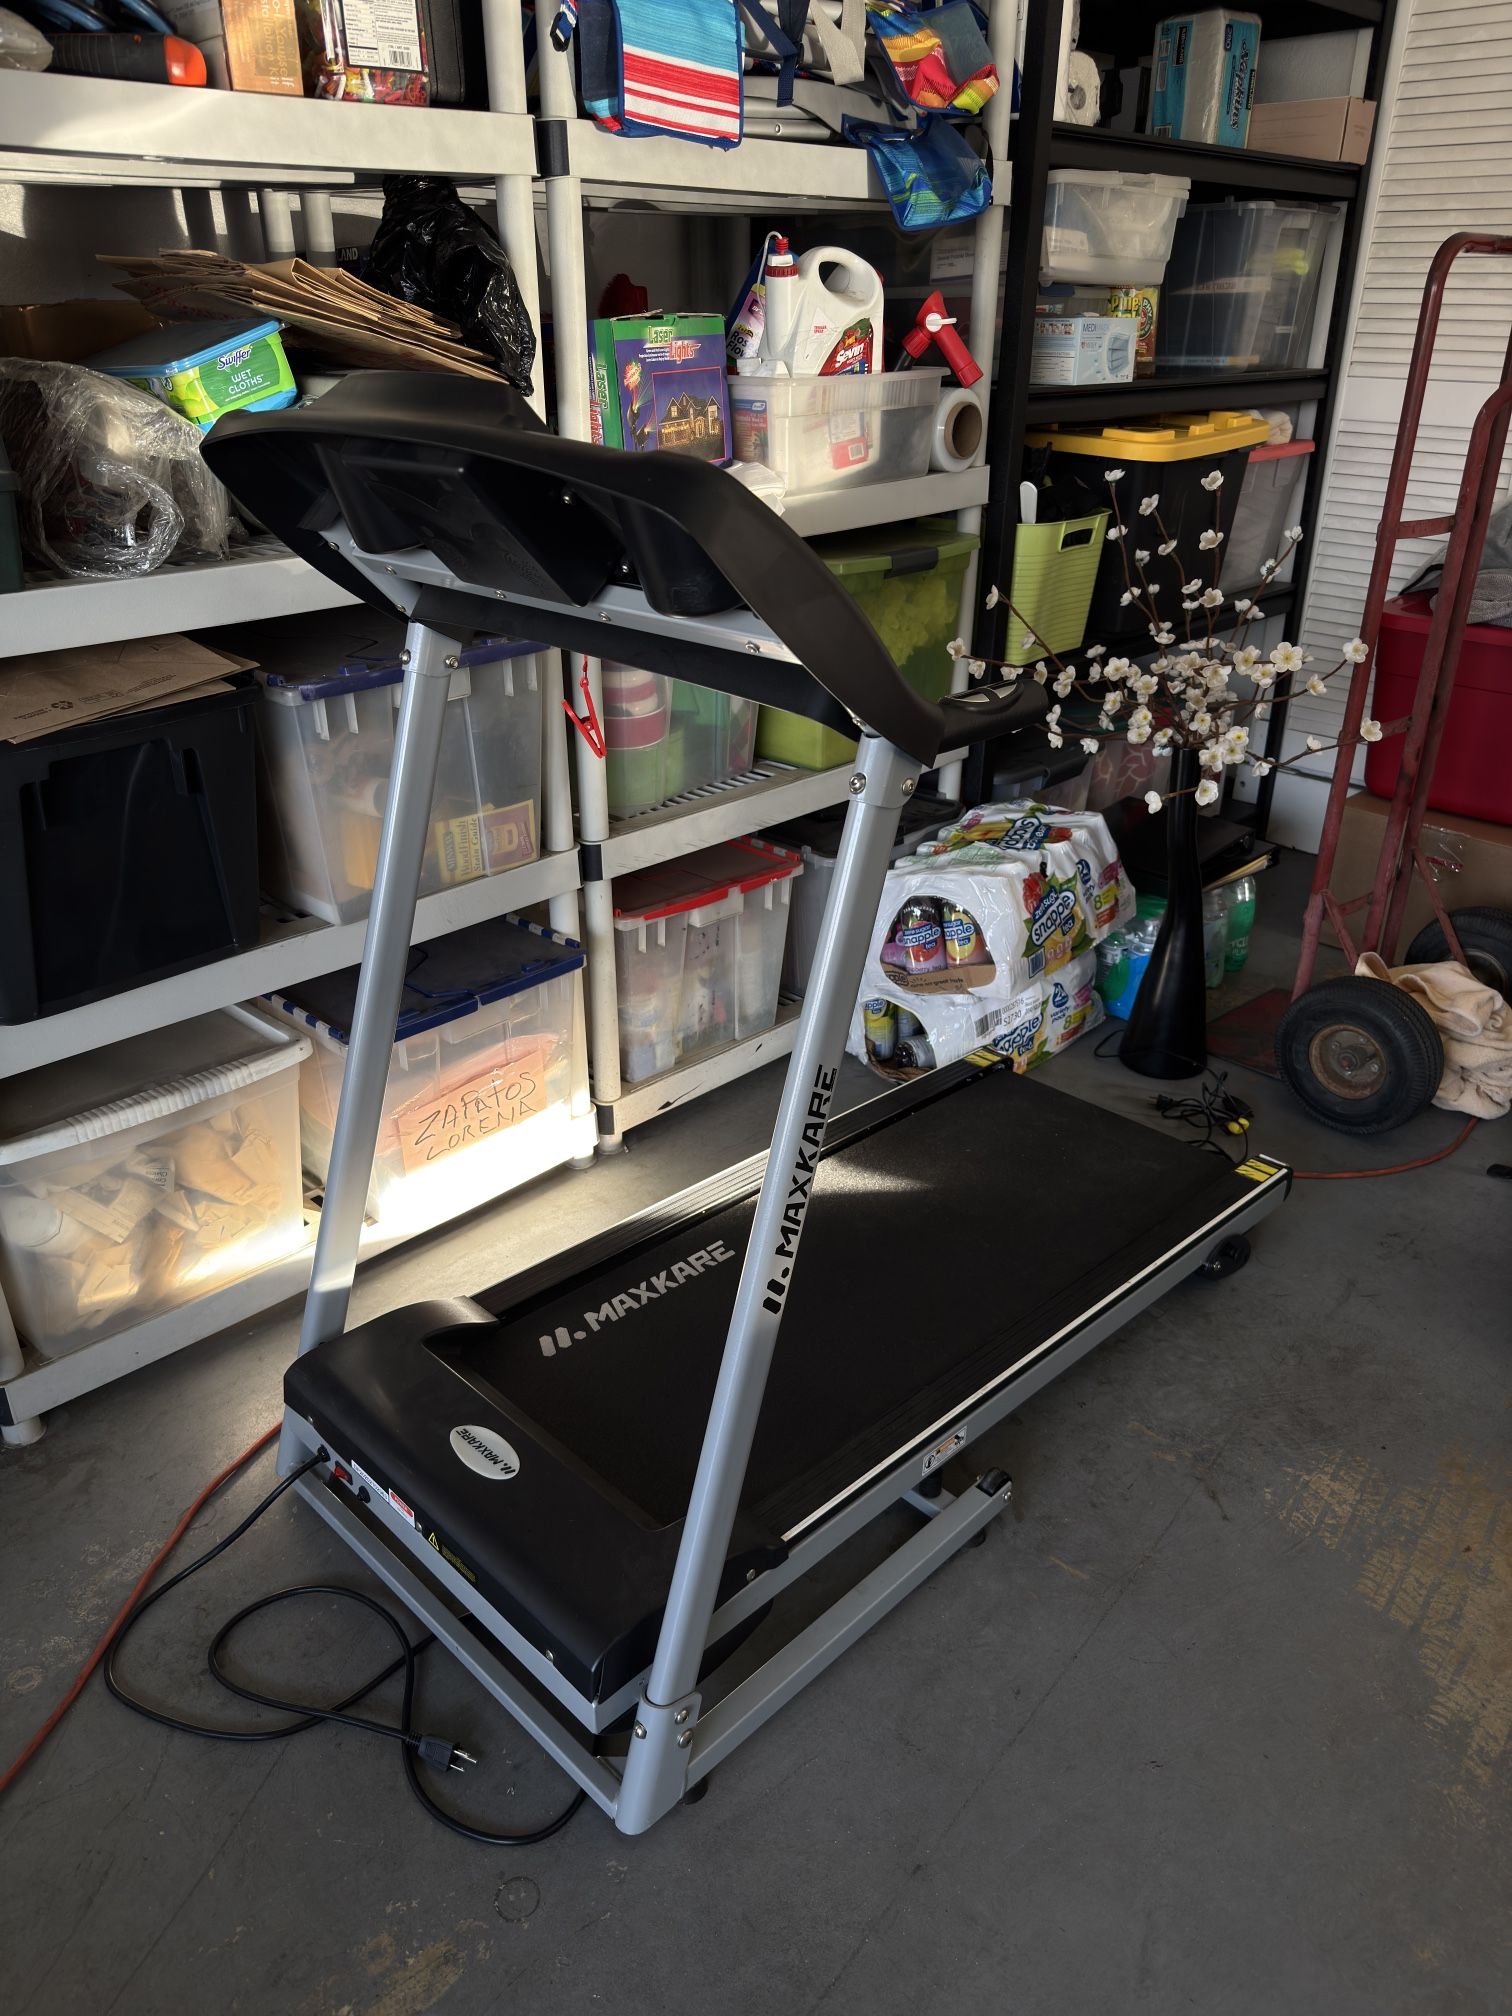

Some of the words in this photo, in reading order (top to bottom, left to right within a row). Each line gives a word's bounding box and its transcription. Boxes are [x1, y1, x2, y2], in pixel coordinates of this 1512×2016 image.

[1111, 294, 1140, 311] Pine
[647, 325, 674, 345] Laser
[216, 347, 252, 371] Swiffer
[835, 342, 865, 369] Sevin
[228, 375, 264, 396] CLOTHS
[231, 368, 252, 384] WET
[471, 817, 480, 846] Guide
[472, 848, 482, 873] Stain
[1063, 1016, 1072, 1030] 8
[414, 1071, 537, 1146] ZAPATOS
[425, 1099, 537, 1162] LORENA
[775, 1063, 838, 1259] MAXKARE
[583, 1239, 736, 1333] MAXKARE
[455, 1428, 505, 1466] MAXKARE
